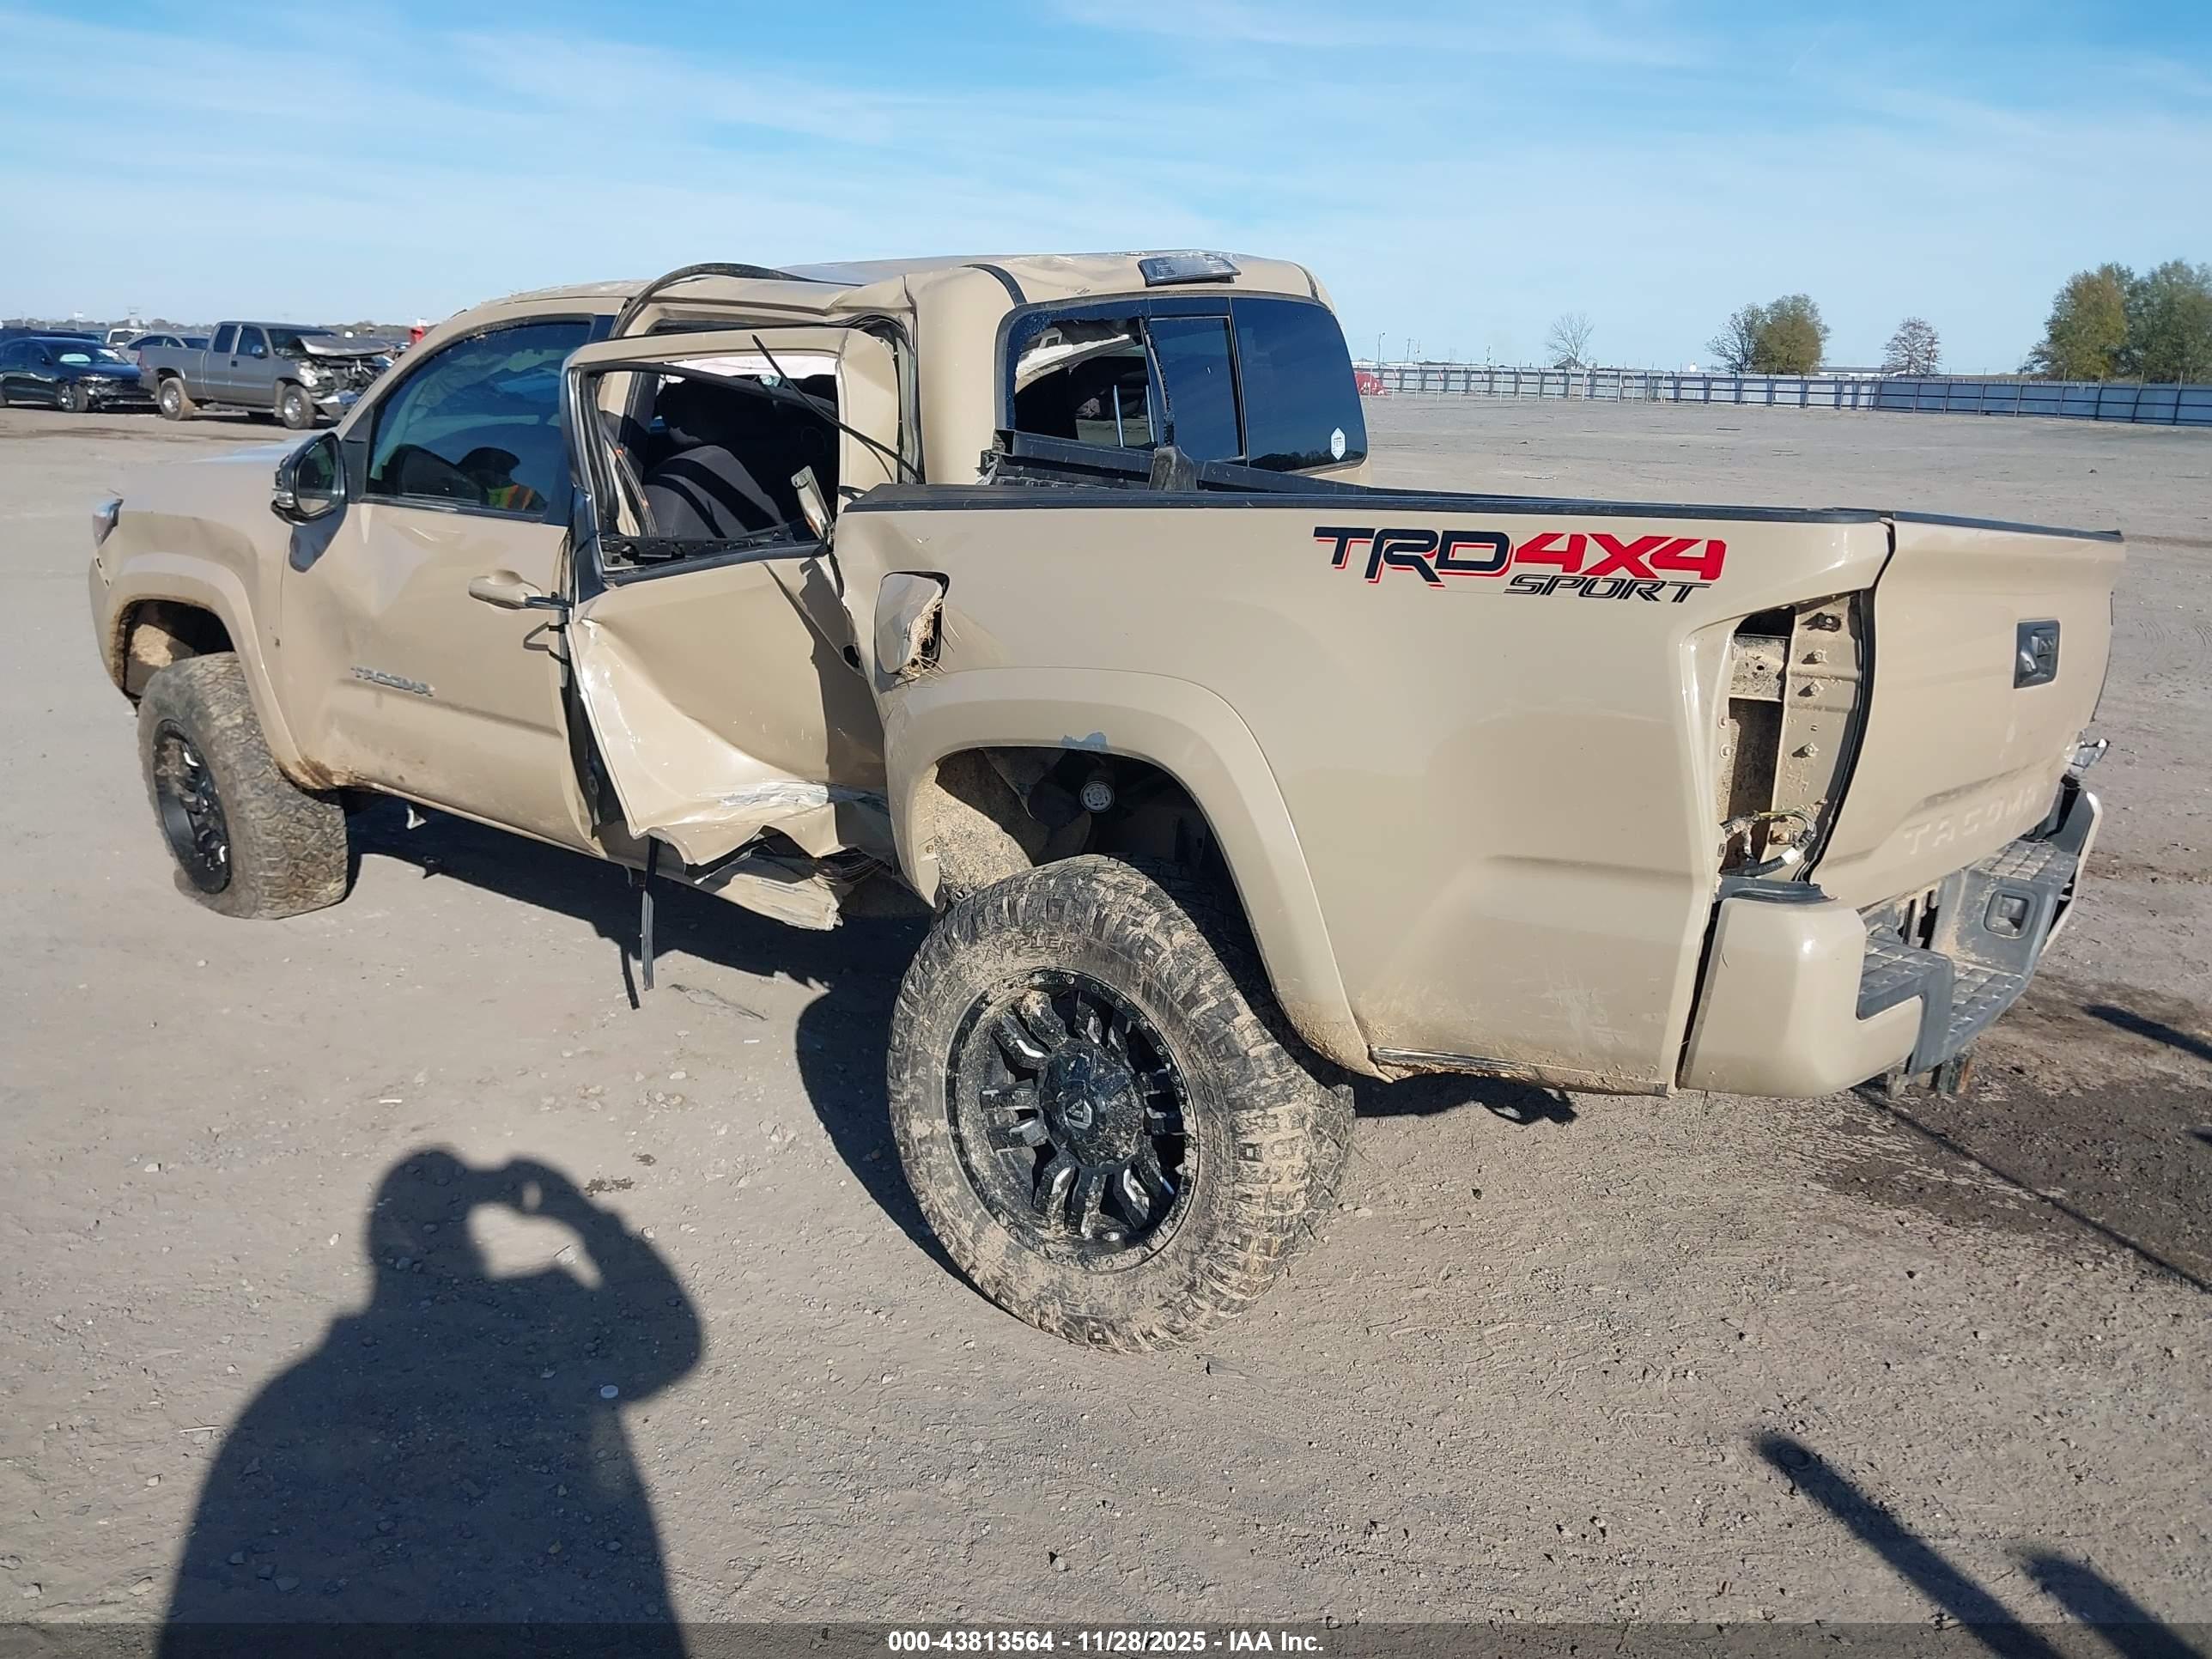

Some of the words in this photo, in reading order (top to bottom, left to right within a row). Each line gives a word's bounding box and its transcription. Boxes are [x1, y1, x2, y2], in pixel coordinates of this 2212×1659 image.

[1313, 526, 1515, 588] TRD
[1503, 574, 1711, 604] SPORT
[349, 666, 435, 698] TACOMA
[1904, 786, 2038, 855] TACOMA
